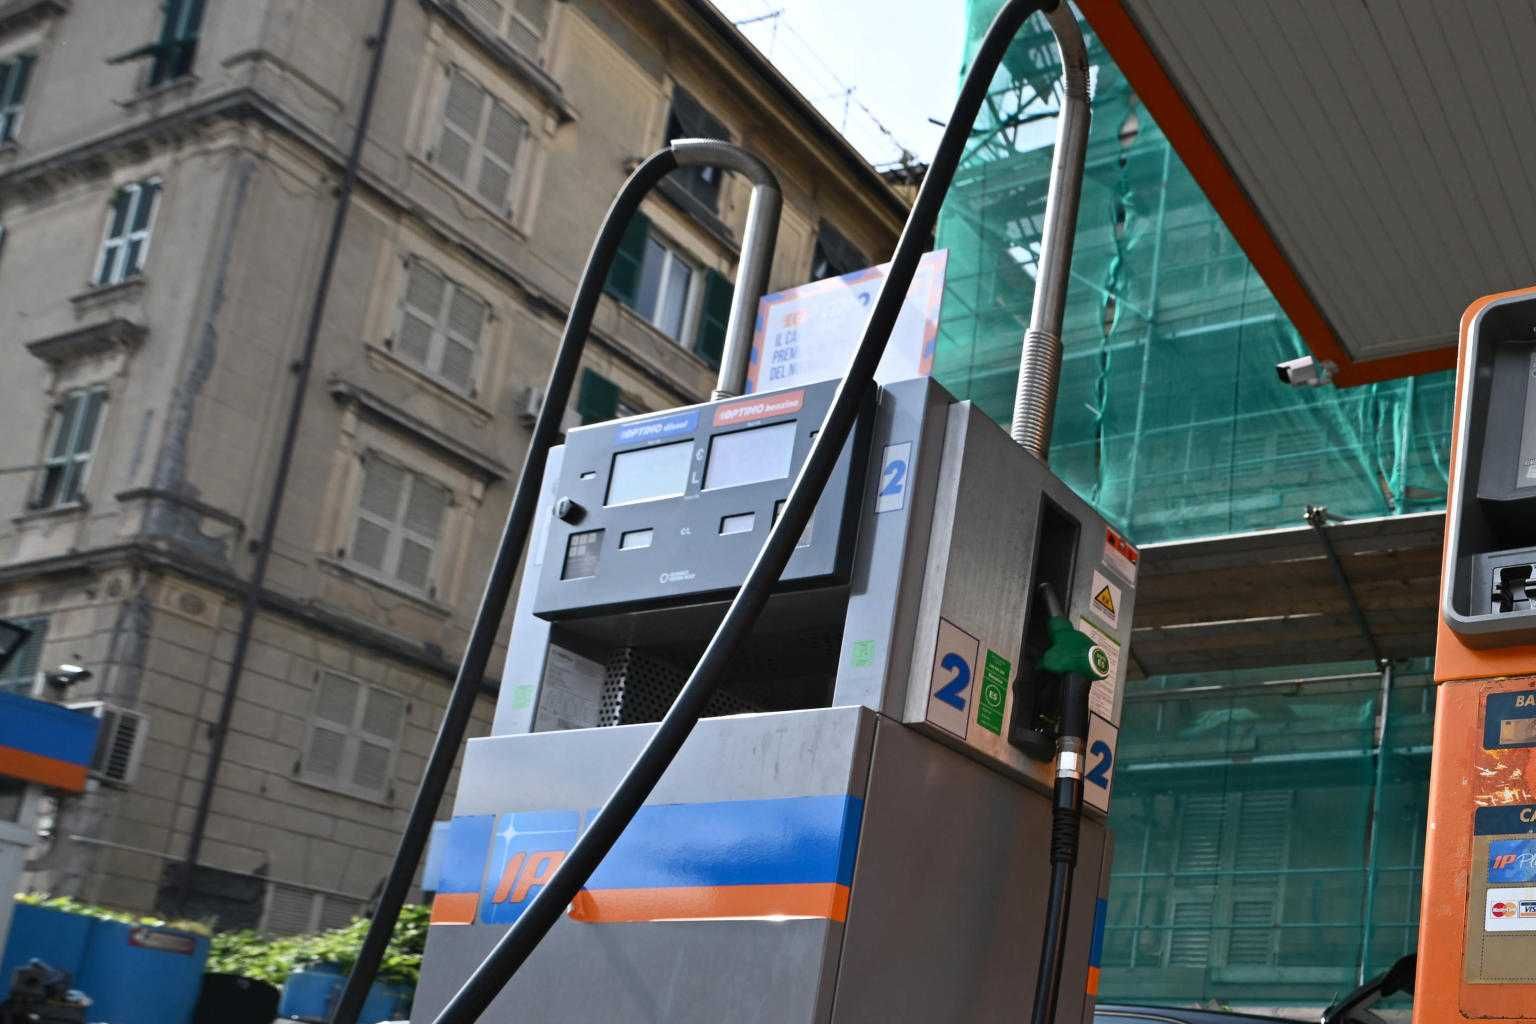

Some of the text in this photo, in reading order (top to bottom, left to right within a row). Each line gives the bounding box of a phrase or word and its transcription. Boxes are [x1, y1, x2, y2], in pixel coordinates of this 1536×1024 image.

[879, 460, 908, 497] 2
[933, 652, 971, 713] 2
[1085, 739, 1113, 791] 2
[493, 850, 567, 903] IP
[1493, 854, 1517, 869] IP
